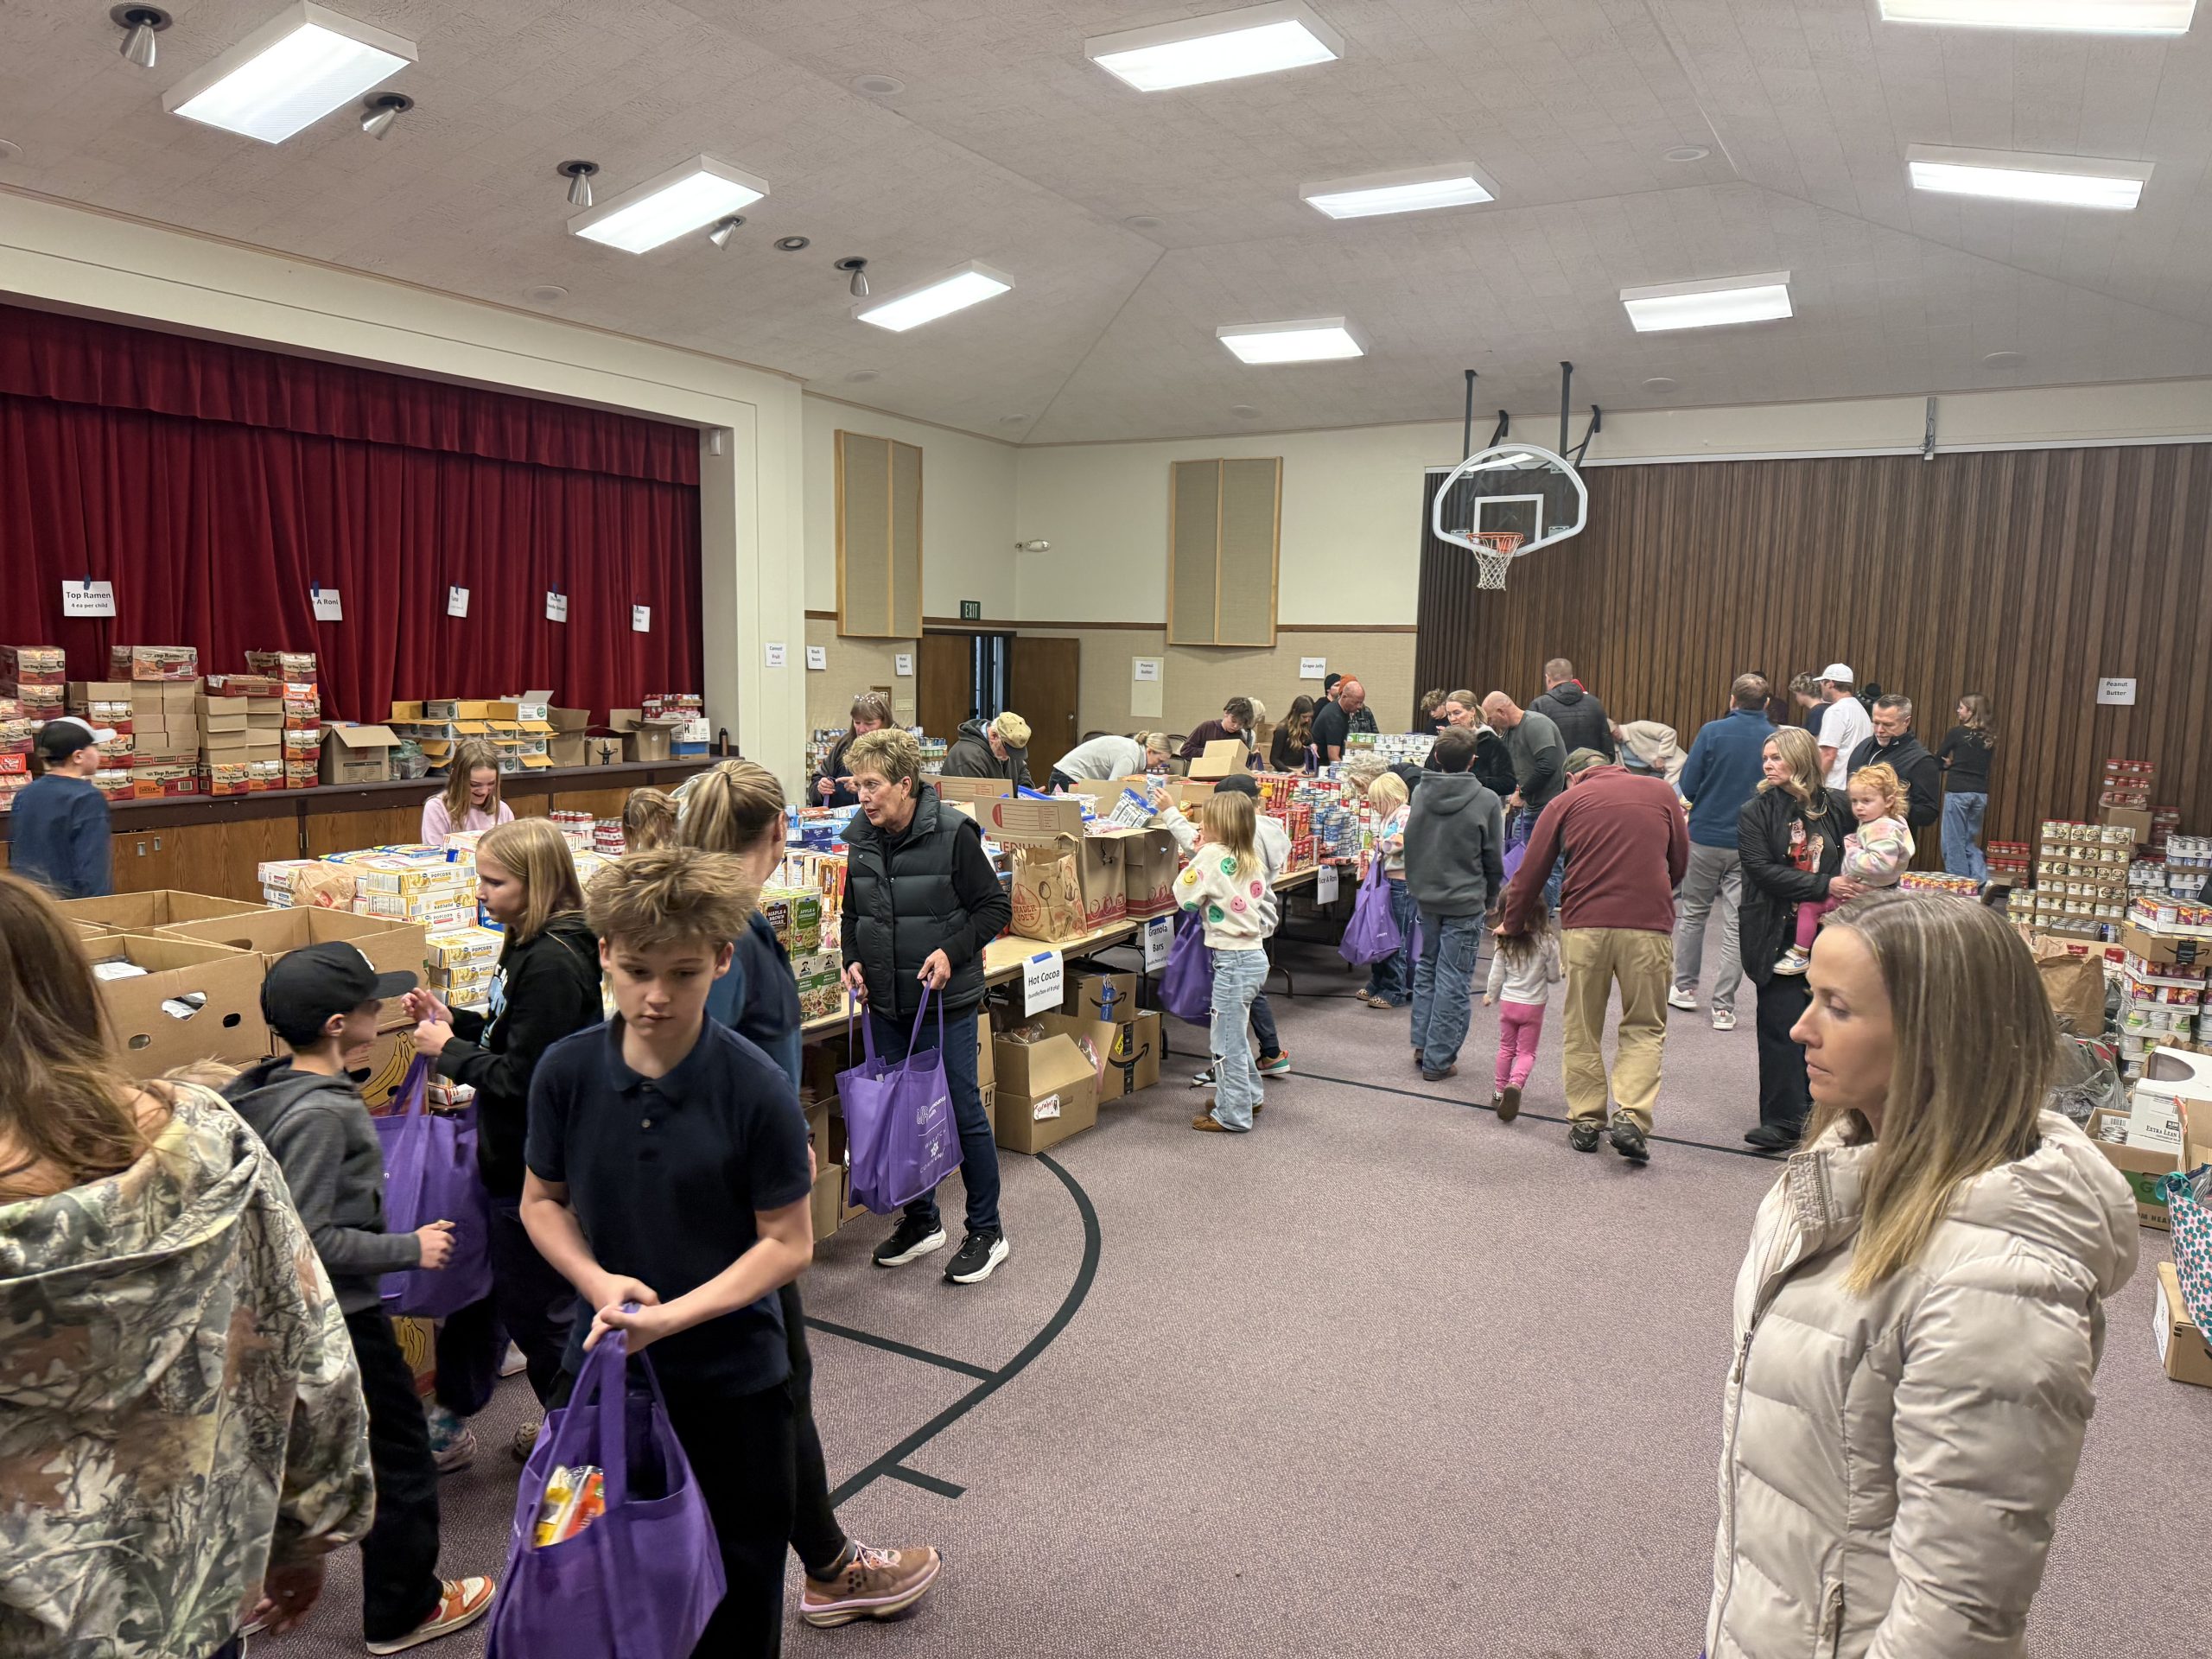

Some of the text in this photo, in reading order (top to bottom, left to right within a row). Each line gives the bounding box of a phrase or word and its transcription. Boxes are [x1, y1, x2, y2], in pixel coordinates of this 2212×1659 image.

[66, 591, 81, 600] Top
[965, 603, 978, 619] EXIT
[1014, 904, 1036, 913] TRADER
[1148, 925, 1168, 937] Granola
[1153, 944, 1164, 952] Bars
[1028, 969, 1060, 986] Hot Cocoa
[2163, 1128, 2178, 1138] LEAN
